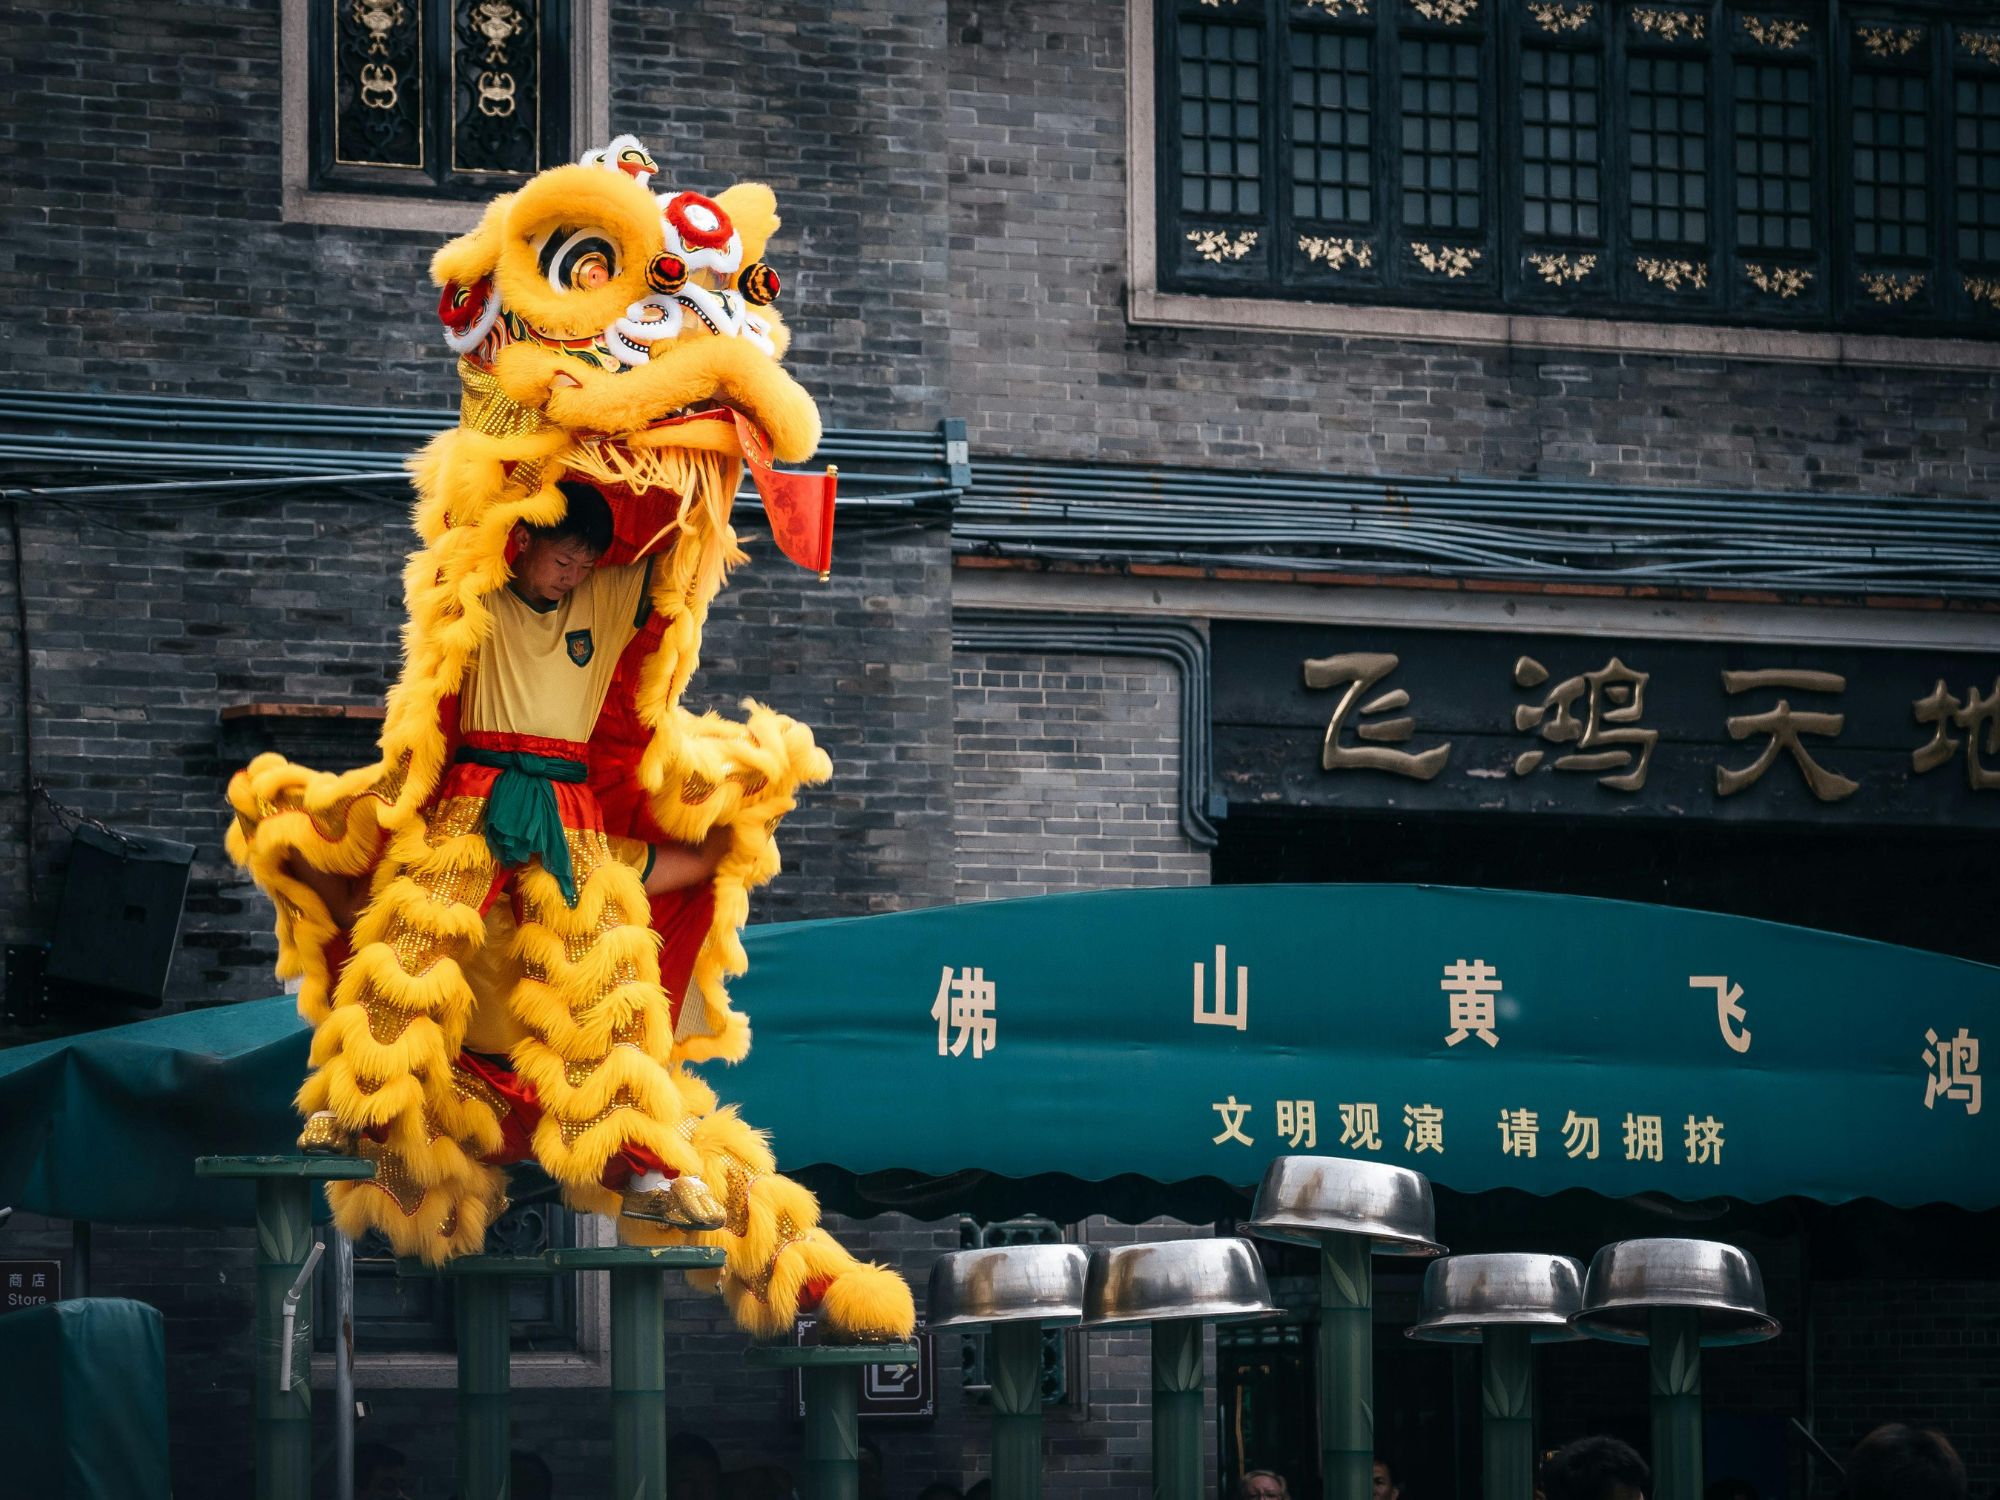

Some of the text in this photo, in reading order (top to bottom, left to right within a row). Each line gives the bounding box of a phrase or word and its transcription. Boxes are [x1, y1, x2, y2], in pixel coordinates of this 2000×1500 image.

[1303, 652, 2000, 800] 飞鸿天地
[931, 944, 1983, 1116] 佛山黄飞鸿
[1212, 1095, 1726, 1166] 文明观演 请勿拥挤
[8, 1272, 46, 1287] 商店
[8, 1292, 46, 1306] Store
